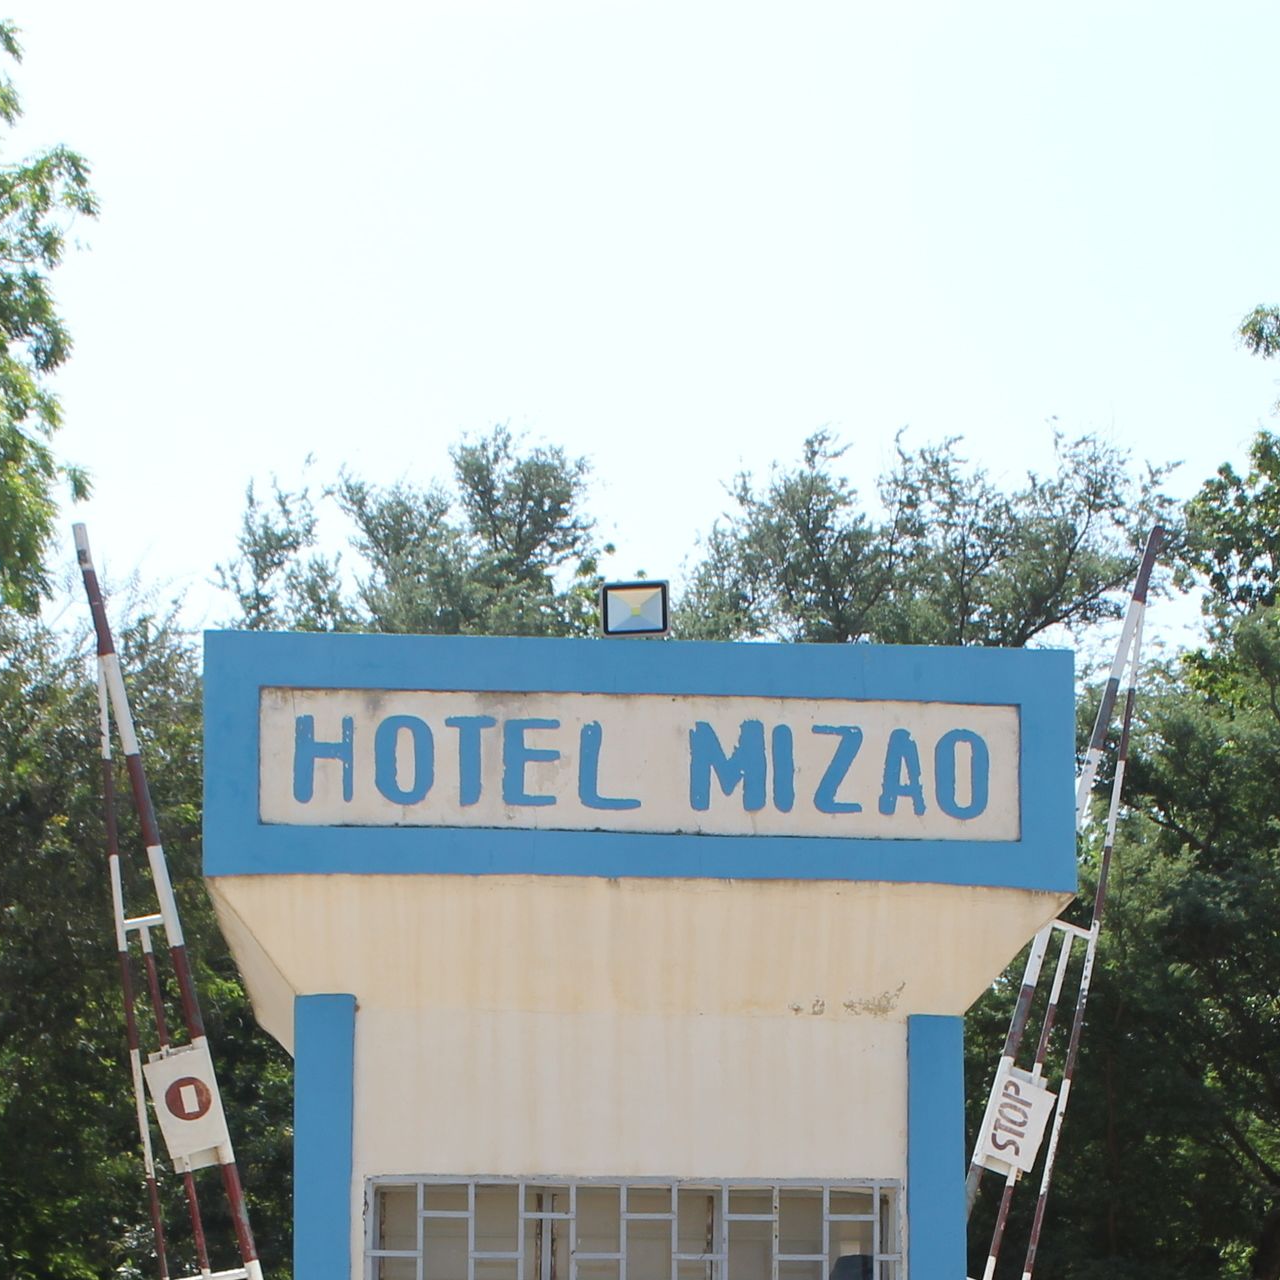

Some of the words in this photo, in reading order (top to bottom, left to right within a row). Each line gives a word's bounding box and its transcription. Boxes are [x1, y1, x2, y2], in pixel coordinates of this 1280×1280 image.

[292, 713, 641, 811] HOTEL
[688, 718, 990, 821] MIZAO
[990, 1079, 1033, 1157] STOP
